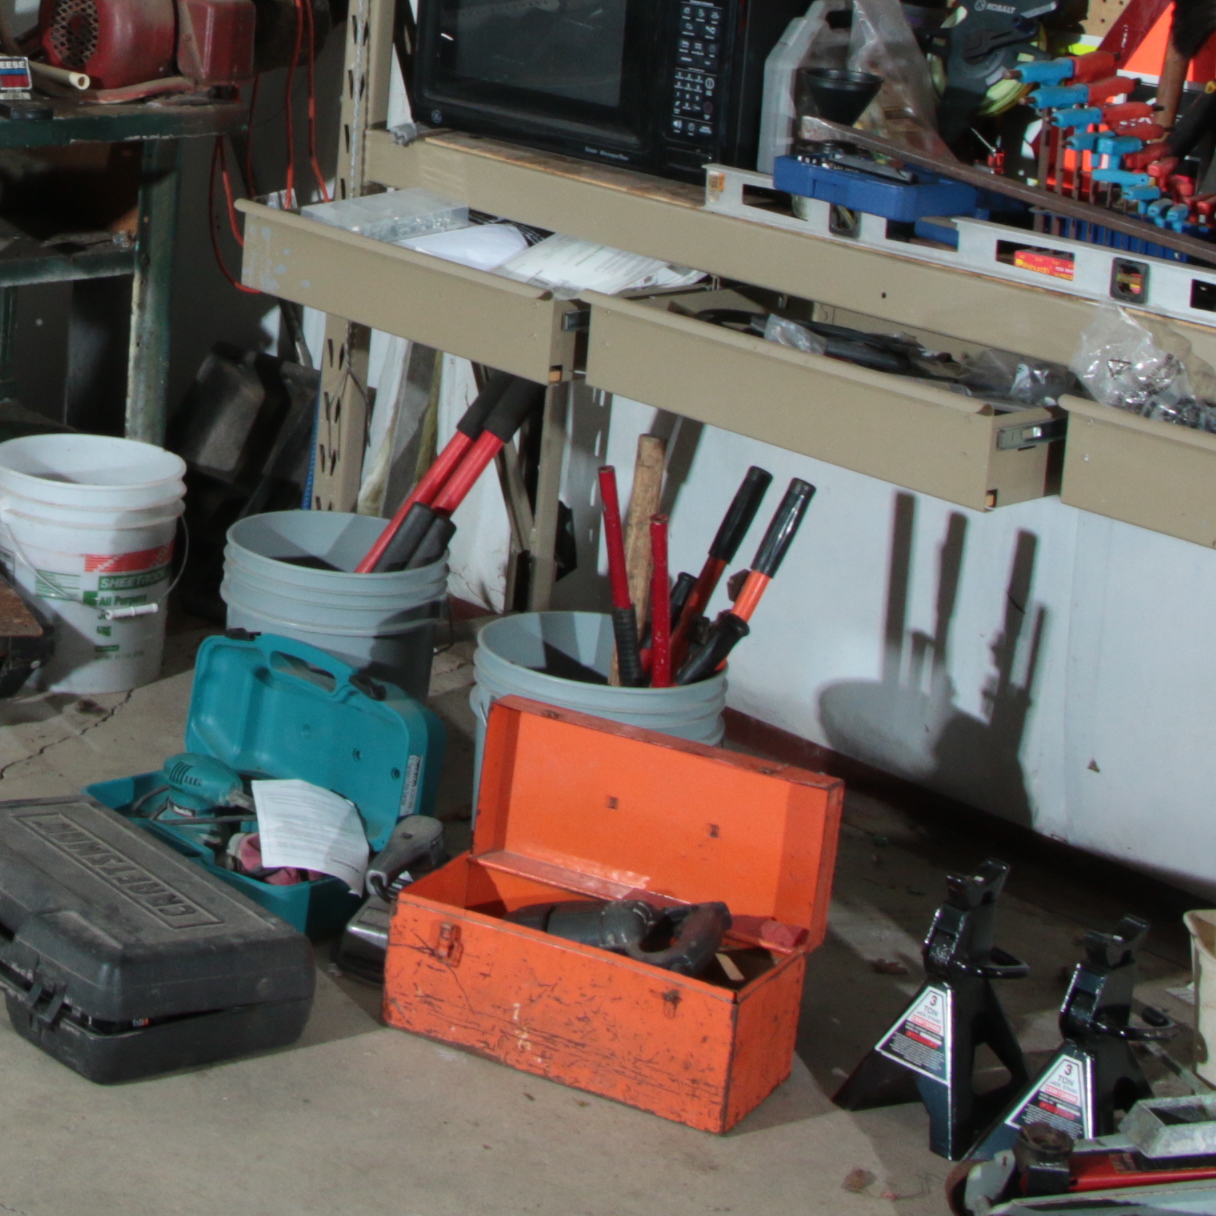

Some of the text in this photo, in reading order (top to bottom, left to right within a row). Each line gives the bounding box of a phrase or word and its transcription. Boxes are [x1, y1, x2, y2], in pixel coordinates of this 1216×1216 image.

[98, 596, 112, 606] All
[929, 994, 937, 1006] 3
[924, 1005, 939, 1017] TON
[1064, 1064, 1073, 1076] 3
[1059, 1074, 1074, 1086] TON
